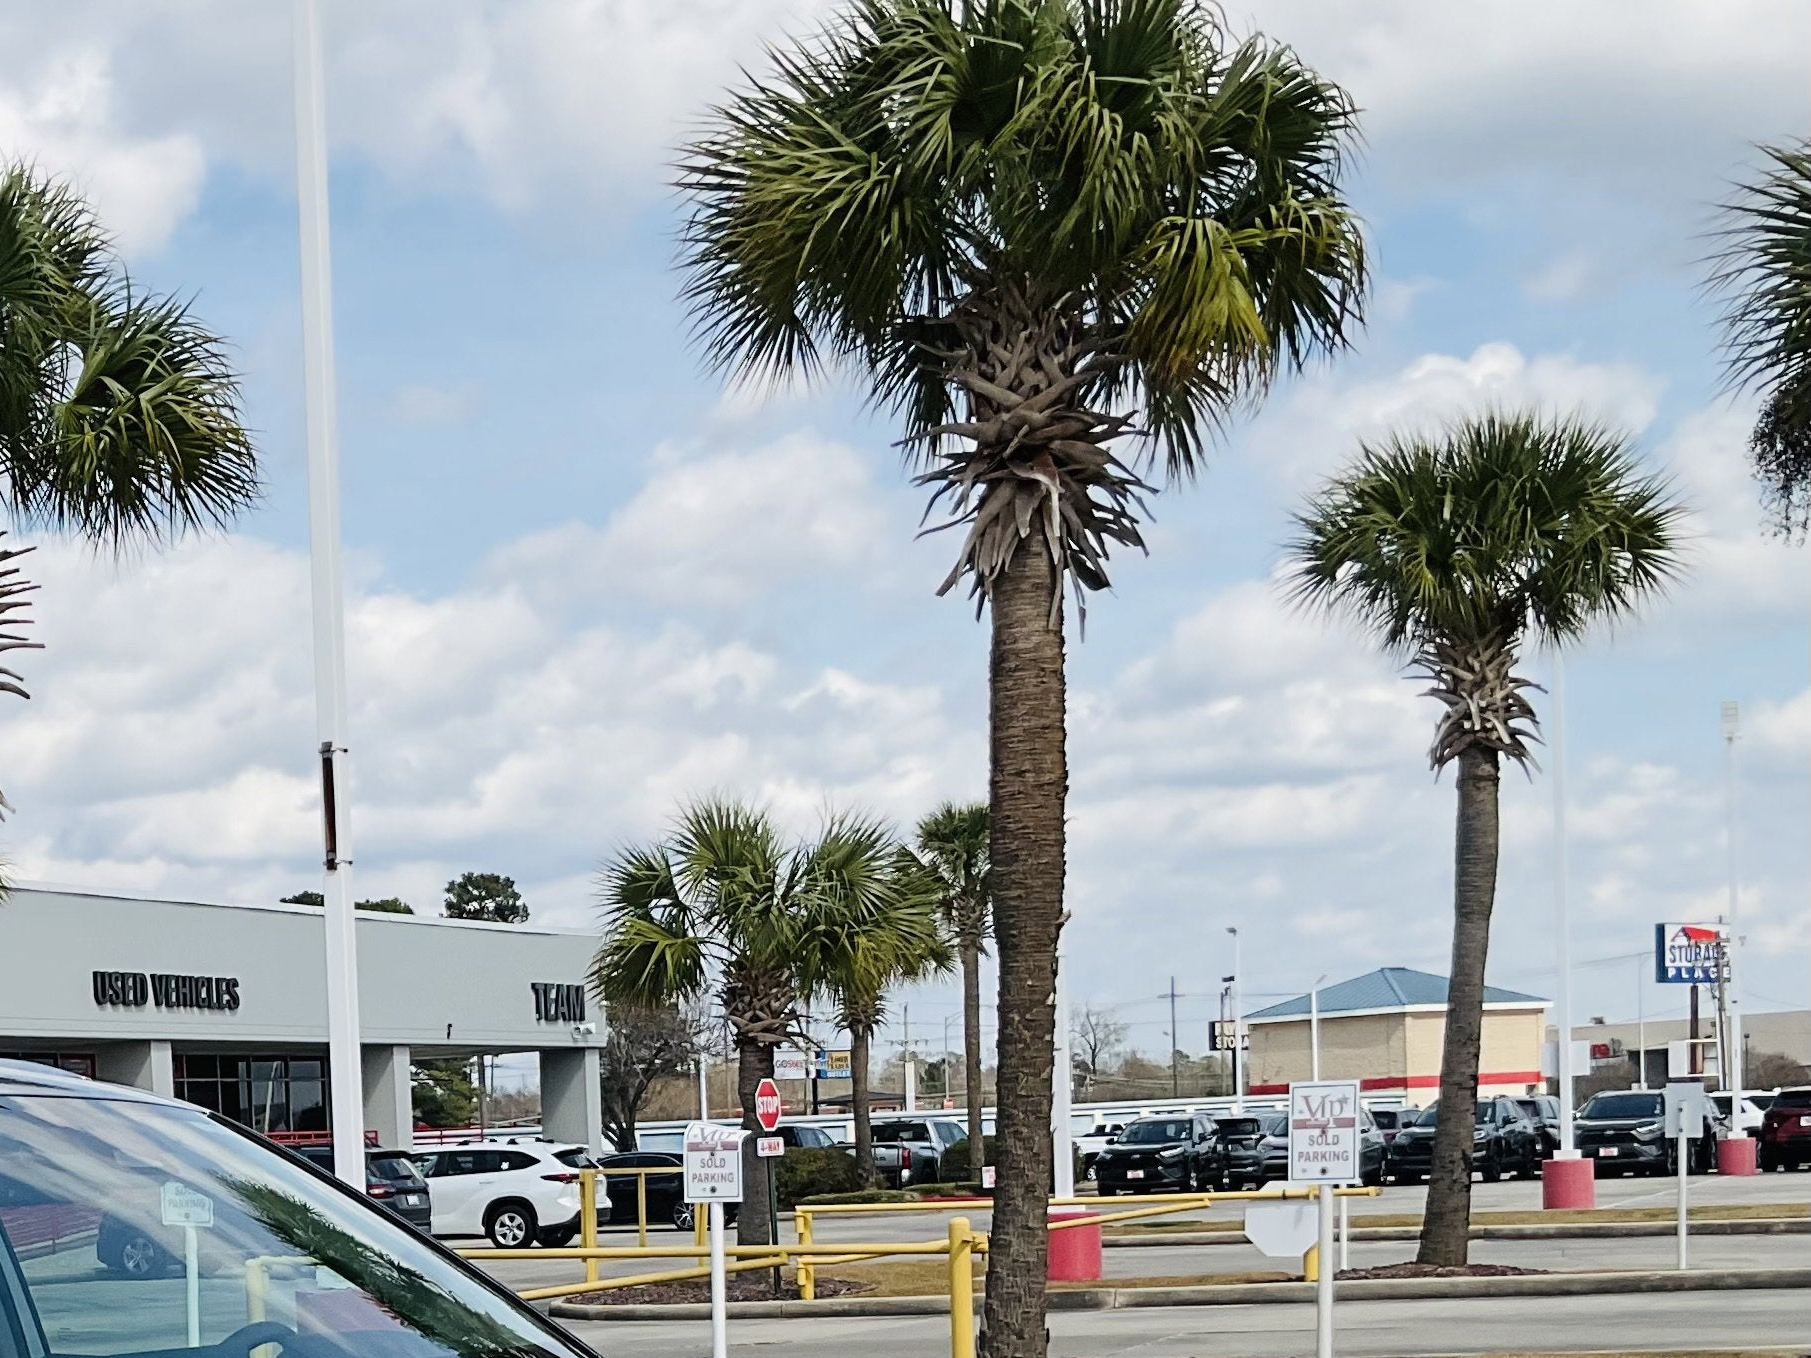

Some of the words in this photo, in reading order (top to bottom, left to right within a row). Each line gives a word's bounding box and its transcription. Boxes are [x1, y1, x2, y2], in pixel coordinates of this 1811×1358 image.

[1668, 967, 1730, 978] PLACE
[92, 971, 148, 1006] USED
[150, 974, 240, 1010] VEHICLES
[531, 983, 585, 1021] TEAM
[758, 1096, 778, 1114] STOP
[1308, 1134, 1340, 1146] SOLD
[1298, 1151, 1349, 1162] PARKING
[700, 1158, 726, 1168] SOLD
[692, 1172, 734, 1183] PARKING
